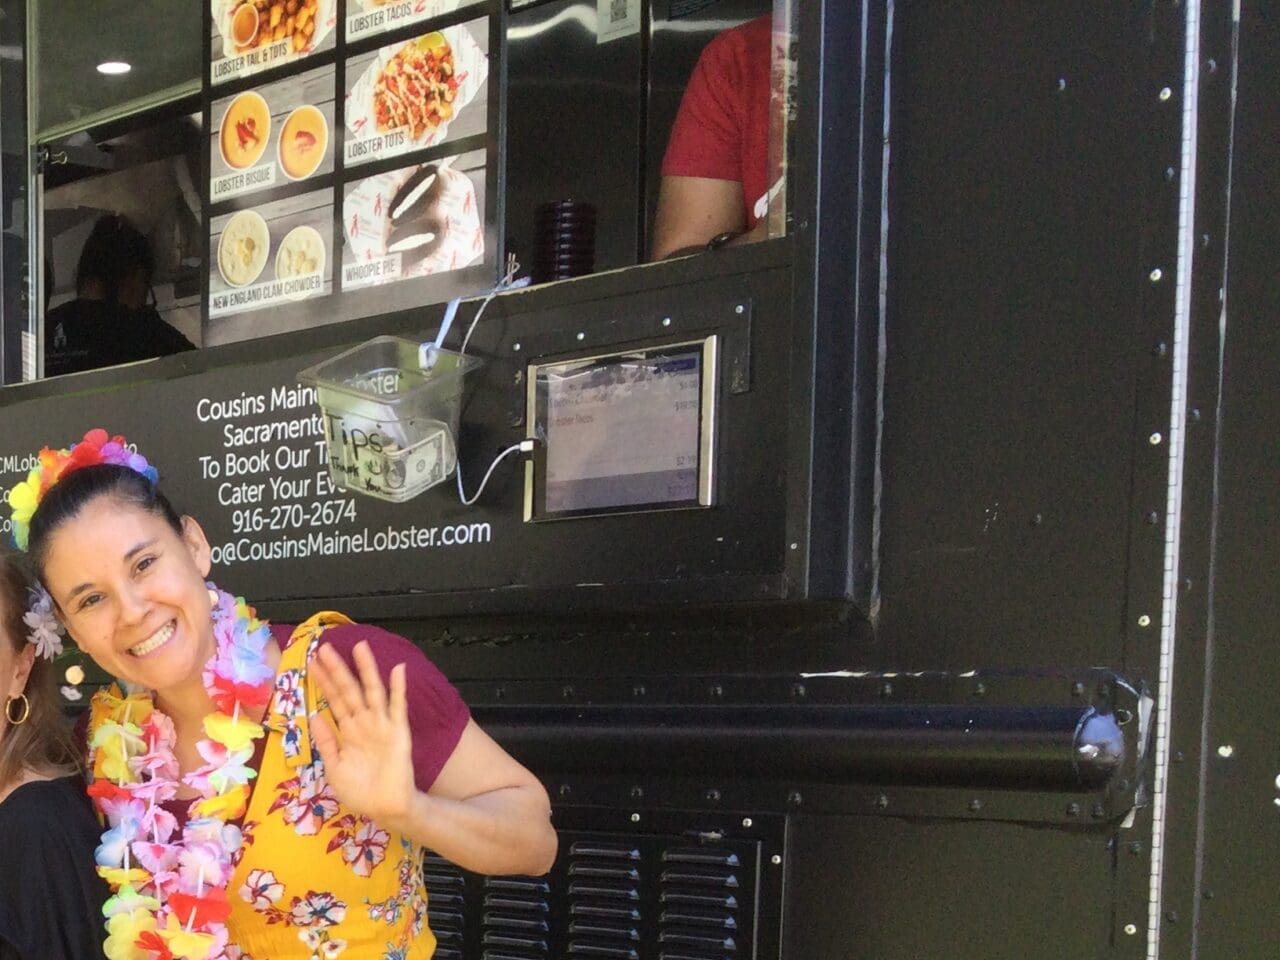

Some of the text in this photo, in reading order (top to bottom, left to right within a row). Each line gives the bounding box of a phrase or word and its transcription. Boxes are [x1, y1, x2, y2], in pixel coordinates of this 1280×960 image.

[349, 2, 412, 34] LOBSTER TACOS
[214, 54, 245, 78] LOBSTER
[246, 51, 261, 67] TAIL
[269, 43, 288, 60] TOTS
[348, 131, 404, 158] LOBSTER TOTS
[214, 166, 271, 194] LOBSTER BISQUE
[346, 258, 396, 281] WHOOPIE PIE
[213, 275, 321, 309] NEW ENGLAND CLAM CHOWDER
[196, 391, 266, 422] Cousins
[199, 456, 221, 479] To
[225, 449, 271, 476] Book
[275, 446, 311, 470] Our
[218, 482, 266, 506] Cater
[269, 475, 312, 501] Your
[232, 498, 357, 534] 916-270-2674
[210, 522, 492, 566] o@CousinsMaineLobster.com
